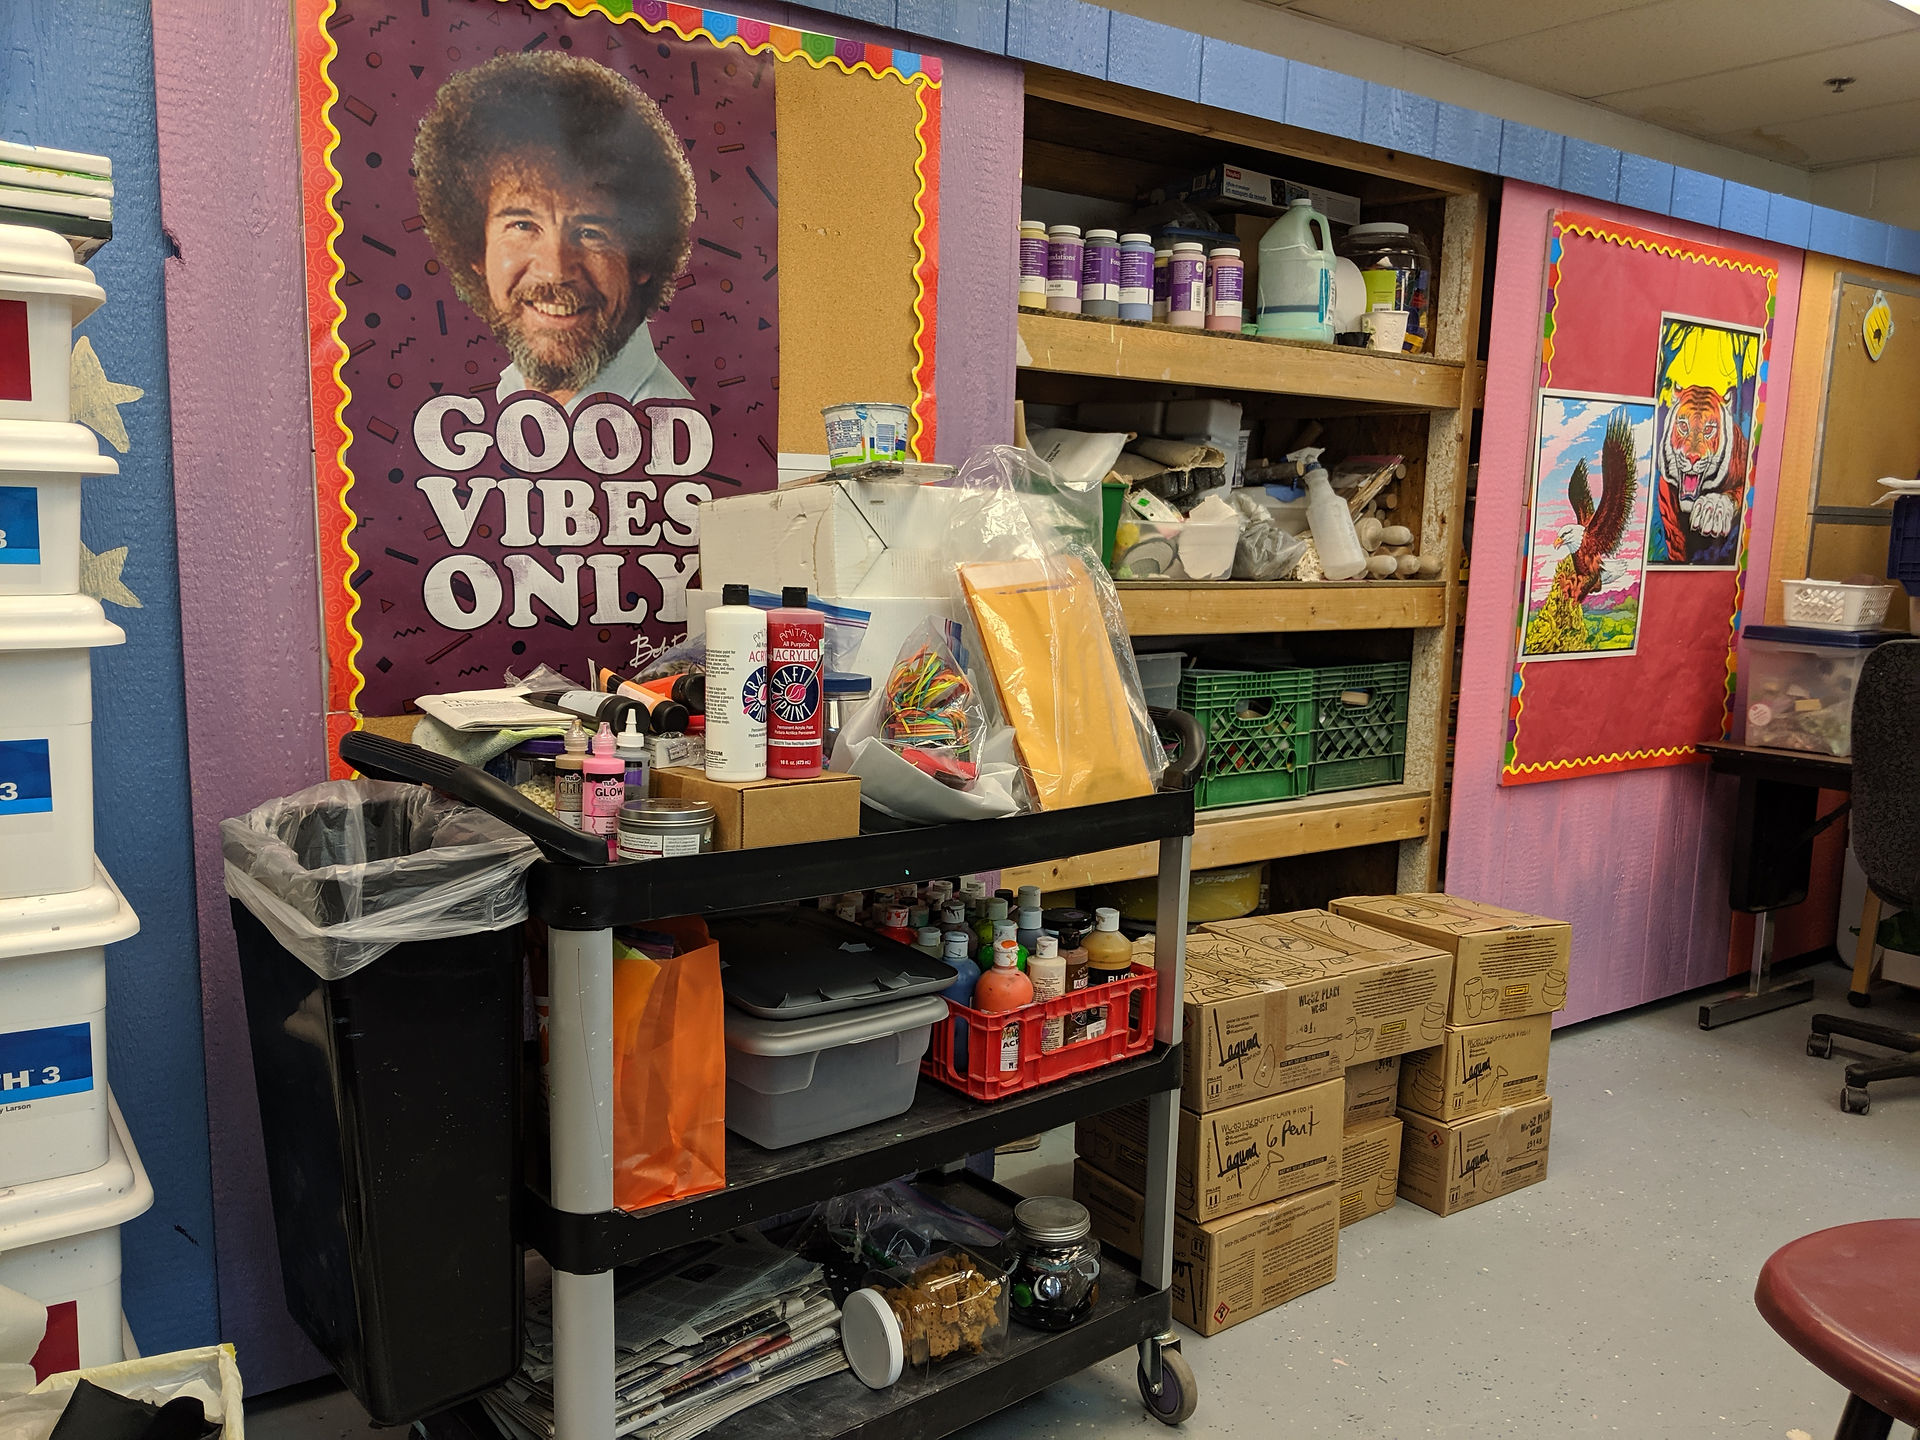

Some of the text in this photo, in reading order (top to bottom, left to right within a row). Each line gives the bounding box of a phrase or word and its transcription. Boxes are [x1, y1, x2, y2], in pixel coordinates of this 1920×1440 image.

[413, 395, 714, 476] GOOD
[416, 476, 713, 547] VIBES
[423, 554, 700, 630] ONLY
[775, 649, 818, 661] ACRYLIC
[772, 666, 807, 695] CRAFT
[775, 700, 812, 721] PAINT
[0, 782, 18, 801] 3
[595, 787, 624, 797] GLOW
[1213, 1008, 1261, 1079] Laguna
[42, 1066, 61, 1084] 3
[5, 1103, 32, 1112] Larson
[1266, 1124, 1278, 1148] 6
[1212, 1120, 1260, 1189] Laguna
